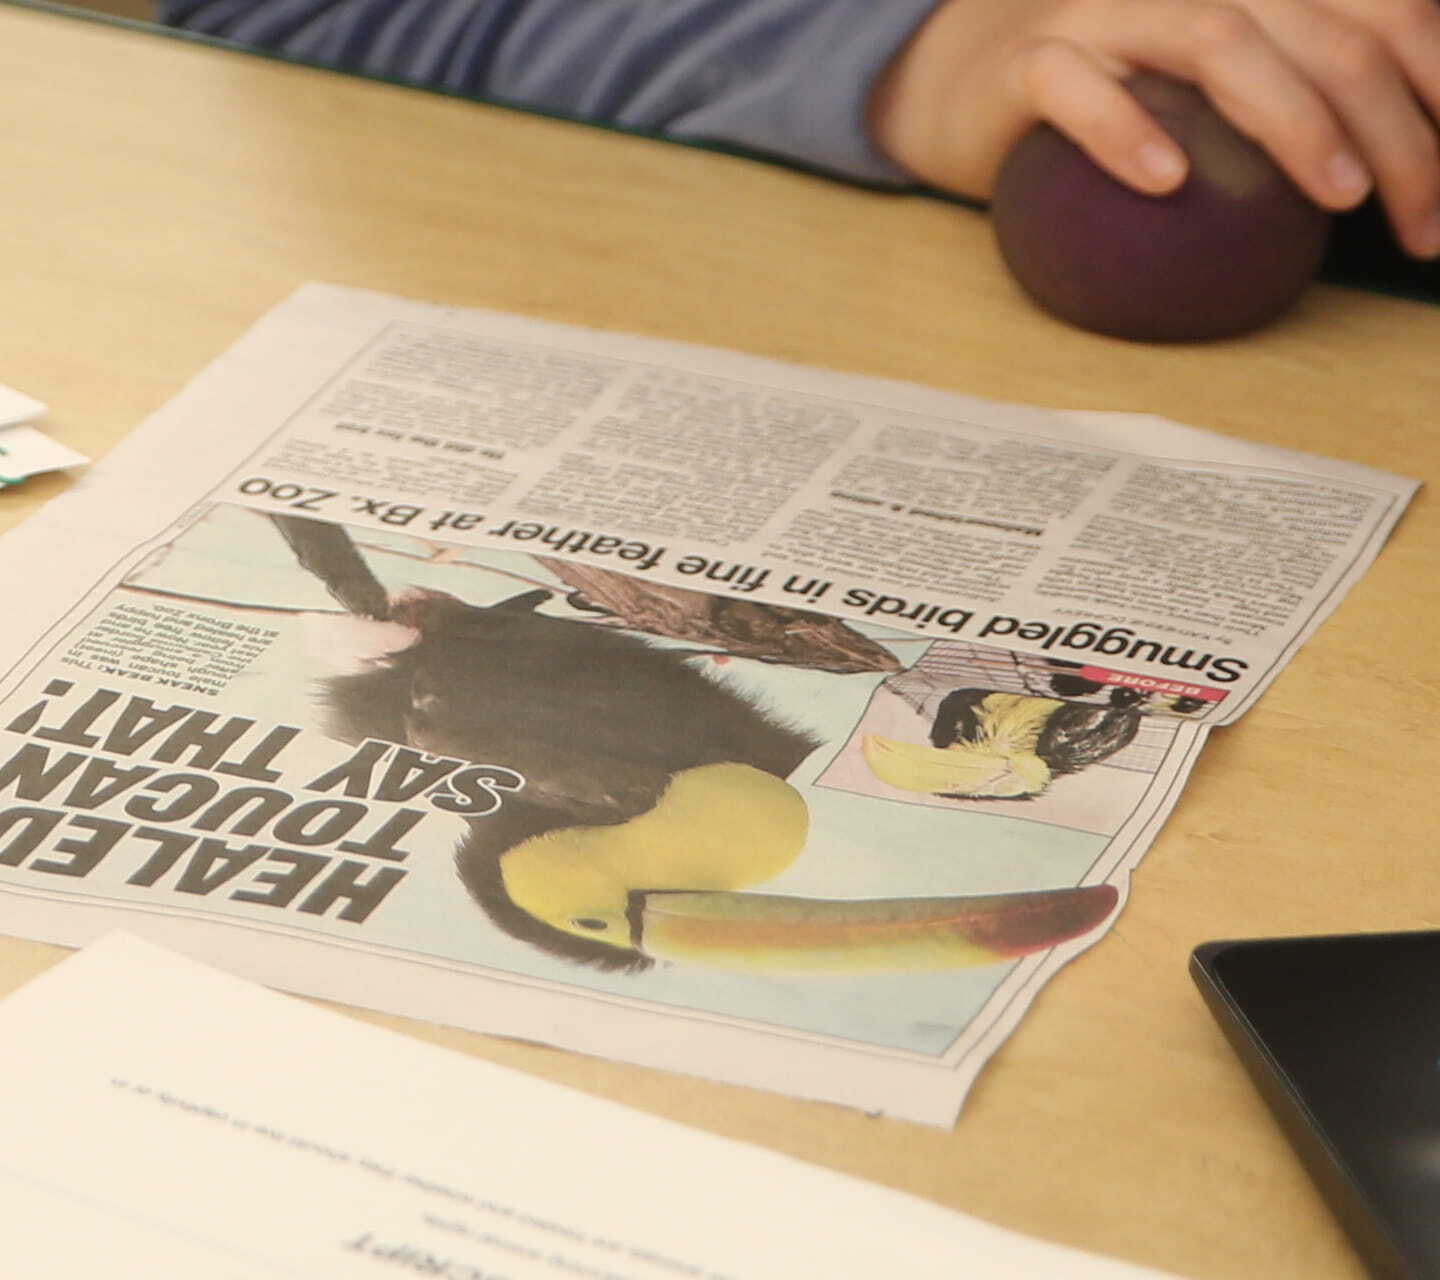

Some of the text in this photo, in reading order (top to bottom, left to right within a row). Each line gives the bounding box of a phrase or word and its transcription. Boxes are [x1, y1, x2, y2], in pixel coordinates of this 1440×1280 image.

[237, 476, 1249, 684] Smuggled birds in fine feather at Bx. Zoo
[184, 613, 233, 629] Bronx
[236, 624, 260, 634] the
[60, 656, 93, 669] This
[128, 662, 181, 678] toucan
[156, 677, 219, 696] SNEAK
[1106, 672, 1202, 696] BEFORE
[4, 678, 524, 816] SAY THAT!
[341, 1232, 501, 1280] CRIPT
